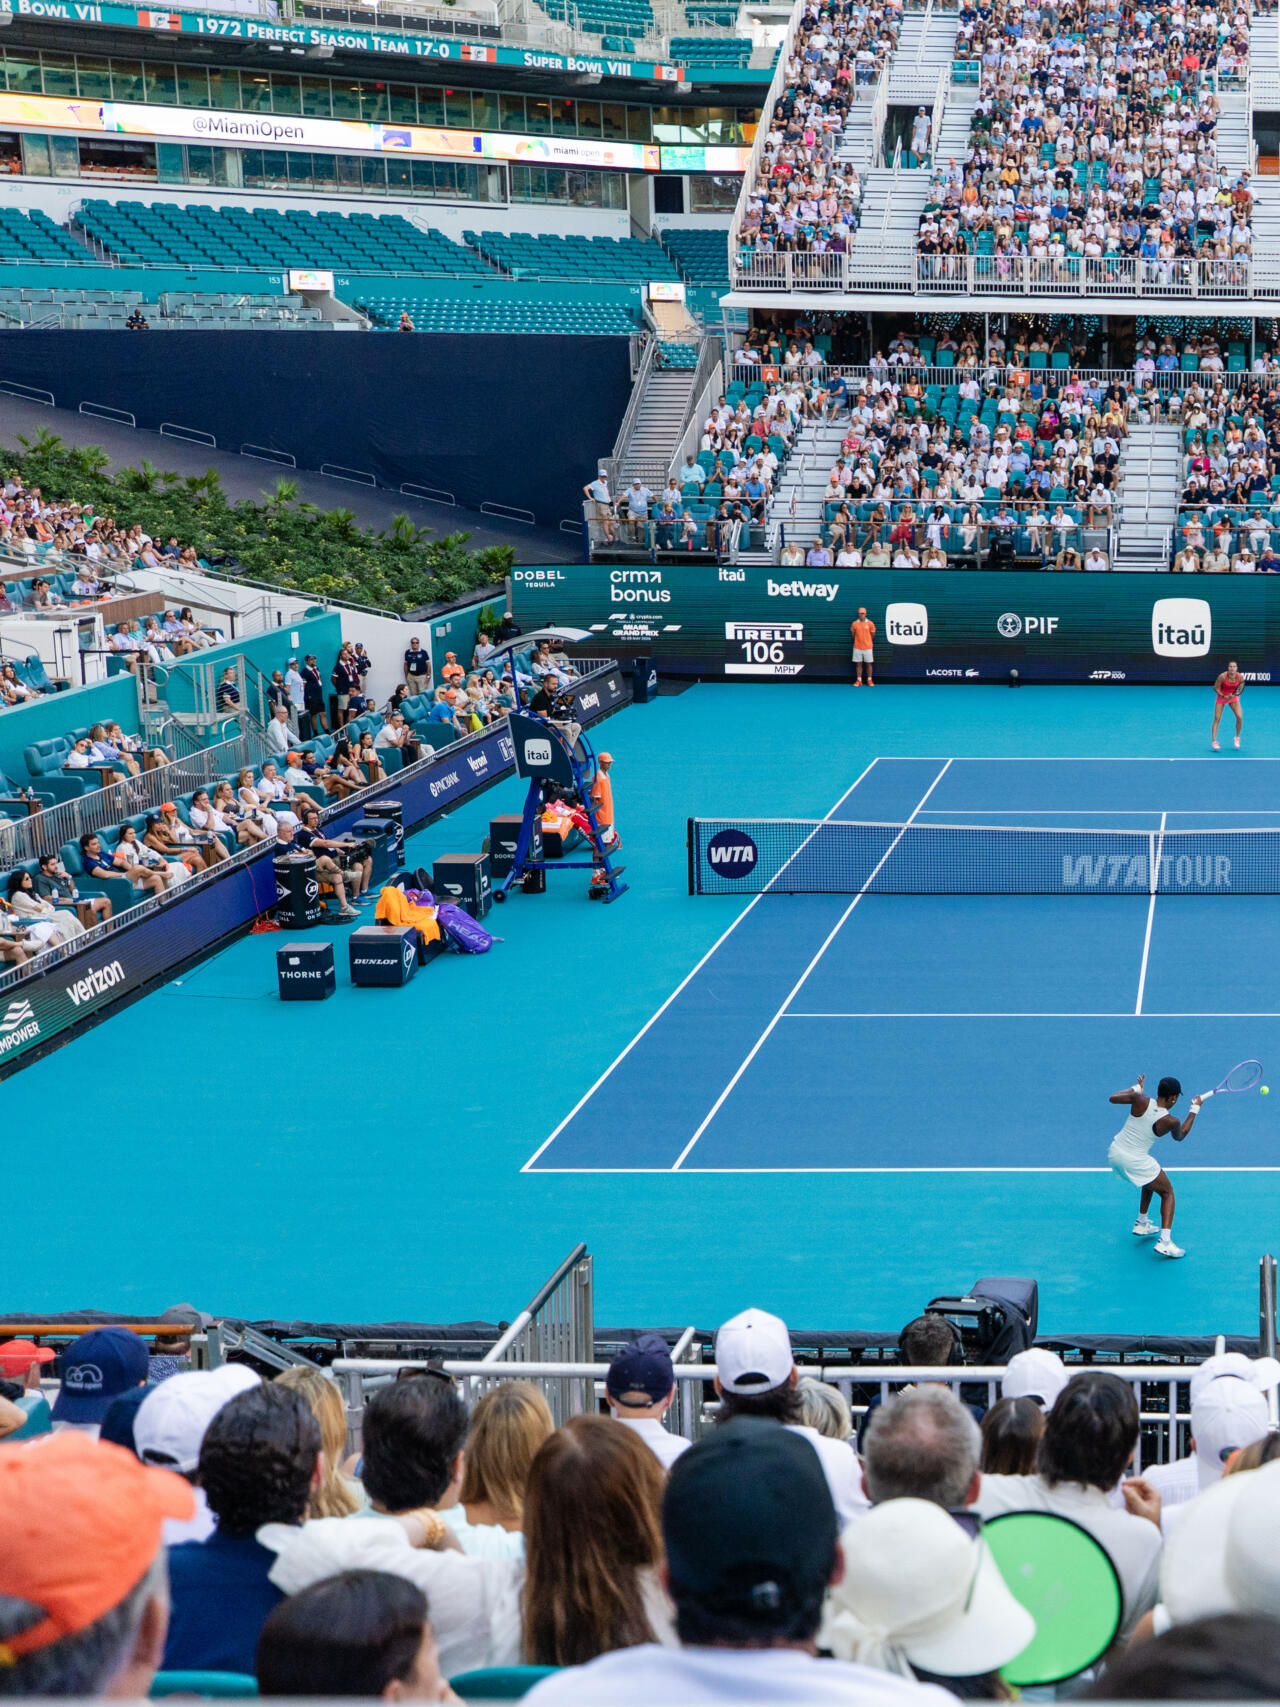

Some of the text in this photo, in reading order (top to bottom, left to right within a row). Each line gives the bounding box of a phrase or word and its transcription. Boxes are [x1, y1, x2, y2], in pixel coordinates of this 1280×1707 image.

[18, 0, 70, 18] BOWL
[196, 17, 450, 58] 1972 PERFECT SEASON TEAM 17-0
[524, 52, 632, 77] SUPER BOWL VIII
[192, 117, 305, 140] @MiamiOpen
[553, 146, 579, 156] miami
[268, 276, 281, 285] 153
[337, 278, 350, 287] 154
[514, 571, 566, 581] DOBEL
[610, 571, 648, 583] crm
[718, 568, 746, 582] itaú
[611, 584, 671, 602] bonus
[767, 579, 839, 602] betway
[636, 613, 663, 621] crypto.com
[1024, 617, 1060, 634] PIF
[725, 621, 804, 641] PIRELLI
[889, 620, 924, 636] itaú
[1157, 623, 1206, 645] itaú
[741, 642, 784, 663] 106
[774, 665, 796, 674] MPH
[1088, 670, 1111, 679] ATP
[1257, 672, 1271, 681] 1000
[579, 691, 600, 711] betway
[467, 751, 488, 771] Veroni
[527, 749, 550, 761] itaú
[710, 846, 754, 864] WTA
[1063, 855, 1232, 887] WTA TOUR
[447, 919, 490, 948] HEAD
[353, 958, 399, 966] DUNLOP
[66, 960, 126, 1006] verizon
[280, 971, 322, 979] THORNE
[0, 1021, 41, 1054] MPOWER
